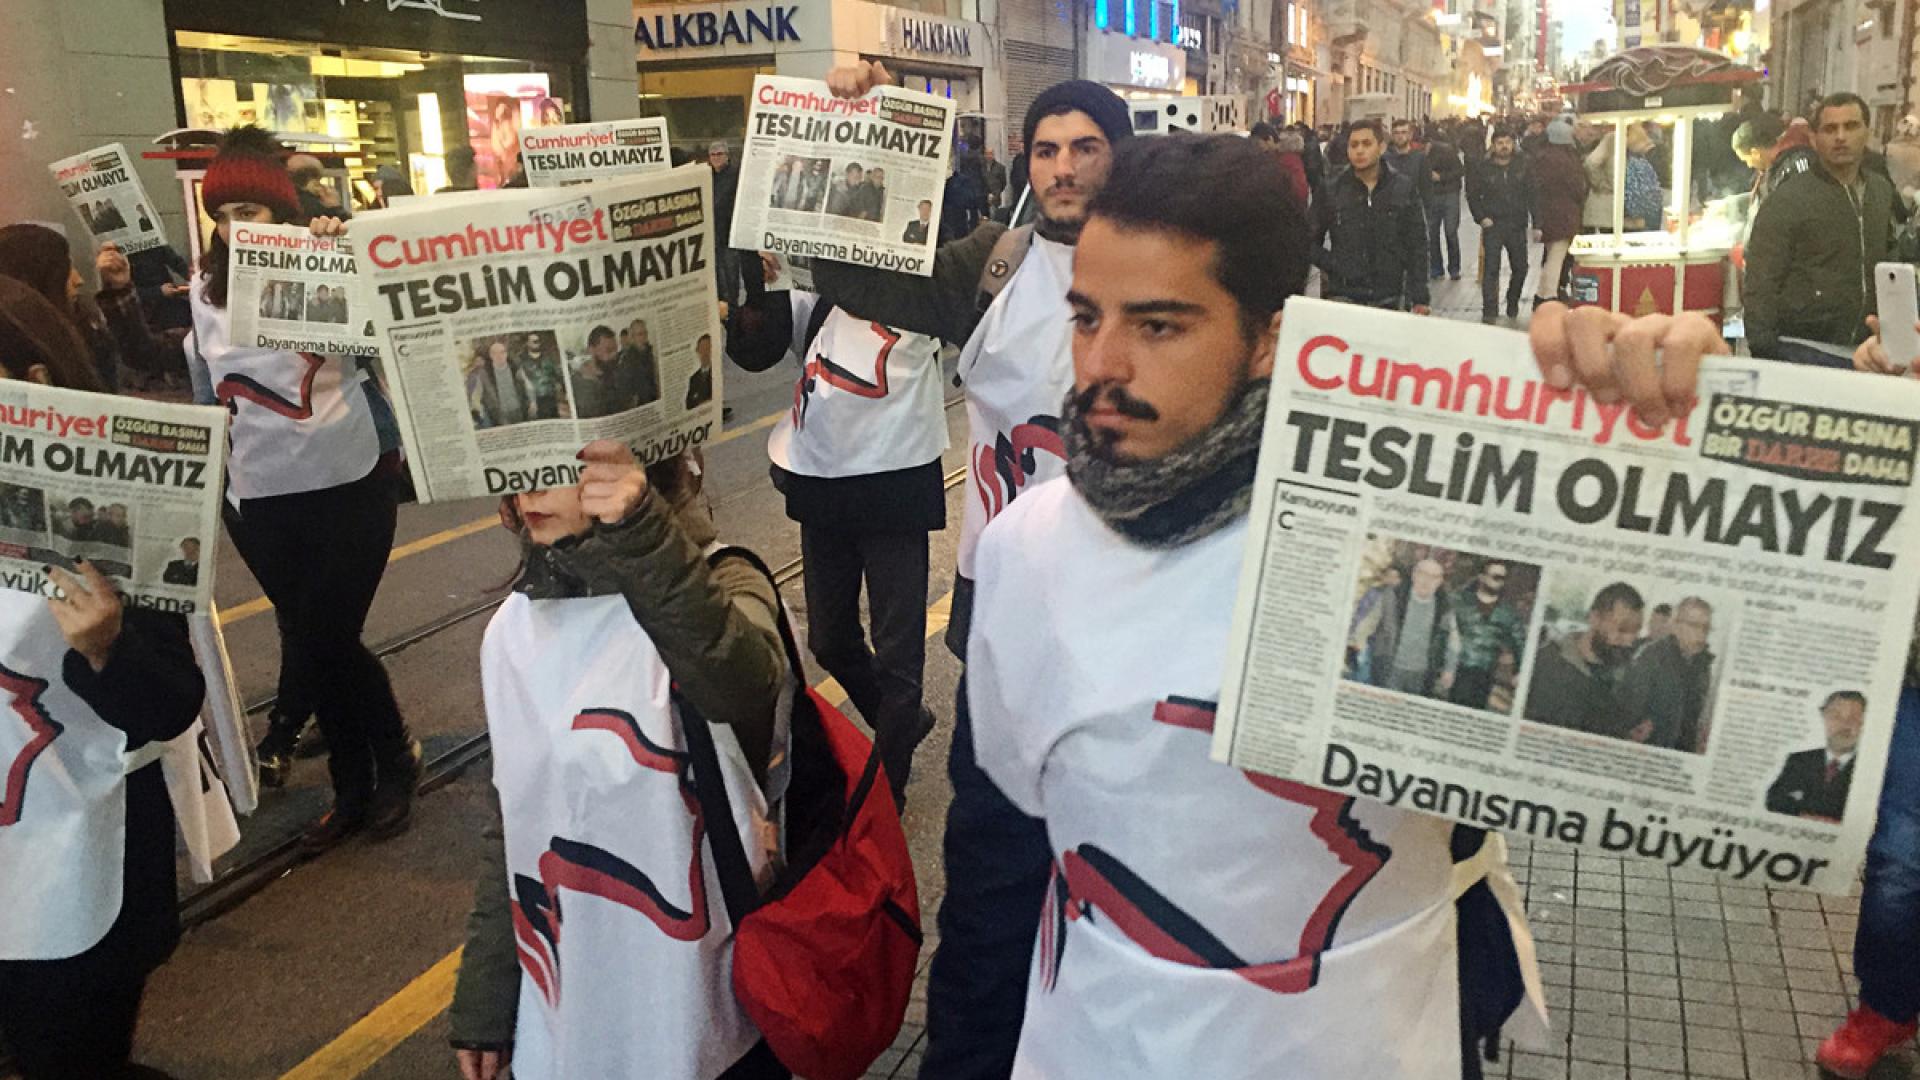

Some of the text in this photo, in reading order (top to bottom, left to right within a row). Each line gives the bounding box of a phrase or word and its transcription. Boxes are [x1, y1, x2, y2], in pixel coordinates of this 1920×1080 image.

[634, 5, 801, 50] ALKBANK
[902, 17, 972, 57] HALKBANK
[757, 84, 879, 117] Cumhuriyet
[524, 131, 615, 150] Cumhuriyet
[528, 146, 665, 170] TESLİM OLMAYIZ
[755, 112, 942, 159] TESLİM OLMAYIZ
[81, 168, 129, 192] OLMAYIZ
[235, 248, 305, 270] TESLİM
[367, 207, 609, 269] Cumhuriyet
[851, 244, 924, 273] büyüyor
[378, 264, 537, 321] TESLİM
[543, 233, 707, 301] OLMAYIZ
[1297, 334, 1700, 447] Cumhuriyet
[1713, 397, 1810, 437] ÖZGÜR
[1813, 413, 1912, 450] BASINA
[43, 442, 207, 490] OLMAYIZ
[1703, 429, 1743, 458] BİR
[1844, 452, 1911, 483] DAHA
[1286, 409, 1539, 515] TESLİM
[1556, 457, 1904, 571] OLMAYIZ
[1599, 807, 1830, 886] büyüyor
